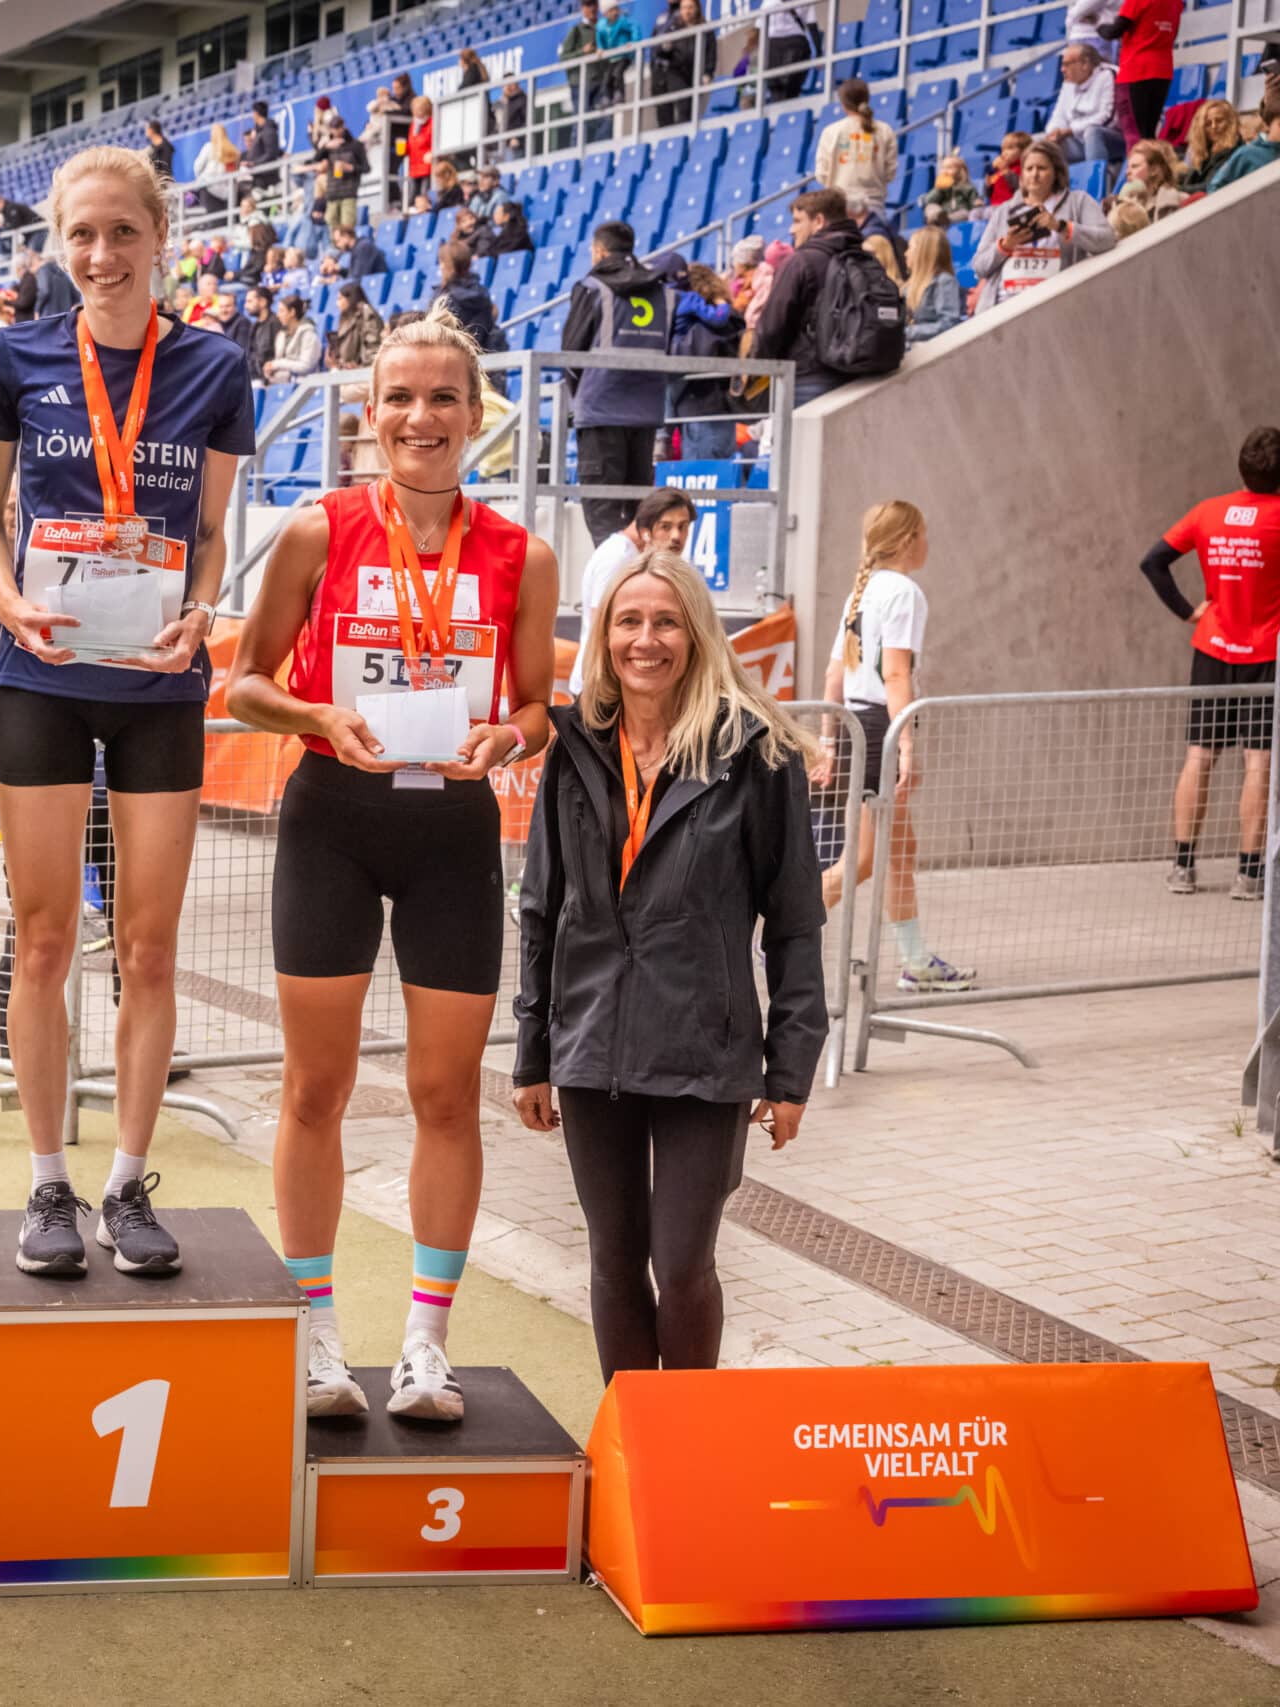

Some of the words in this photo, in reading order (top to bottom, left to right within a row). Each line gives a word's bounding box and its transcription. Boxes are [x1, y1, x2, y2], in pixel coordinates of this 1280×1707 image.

[1013, 258, 1049, 270] 8127
[37, 429, 197, 470] LÖWSTEIN
[133, 471, 194, 492] medical
[1227, 508, 1256, 525] DB
[349, 622, 388, 637] B2Run
[92, 1379, 170, 1507] 1
[794, 1423, 951, 1449] GEMEINSAM
[959, 1416, 1007, 1446] FÜR
[864, 1451, 978, 1477] VIELFALT
[421, 1487, 465, 1542] 3
